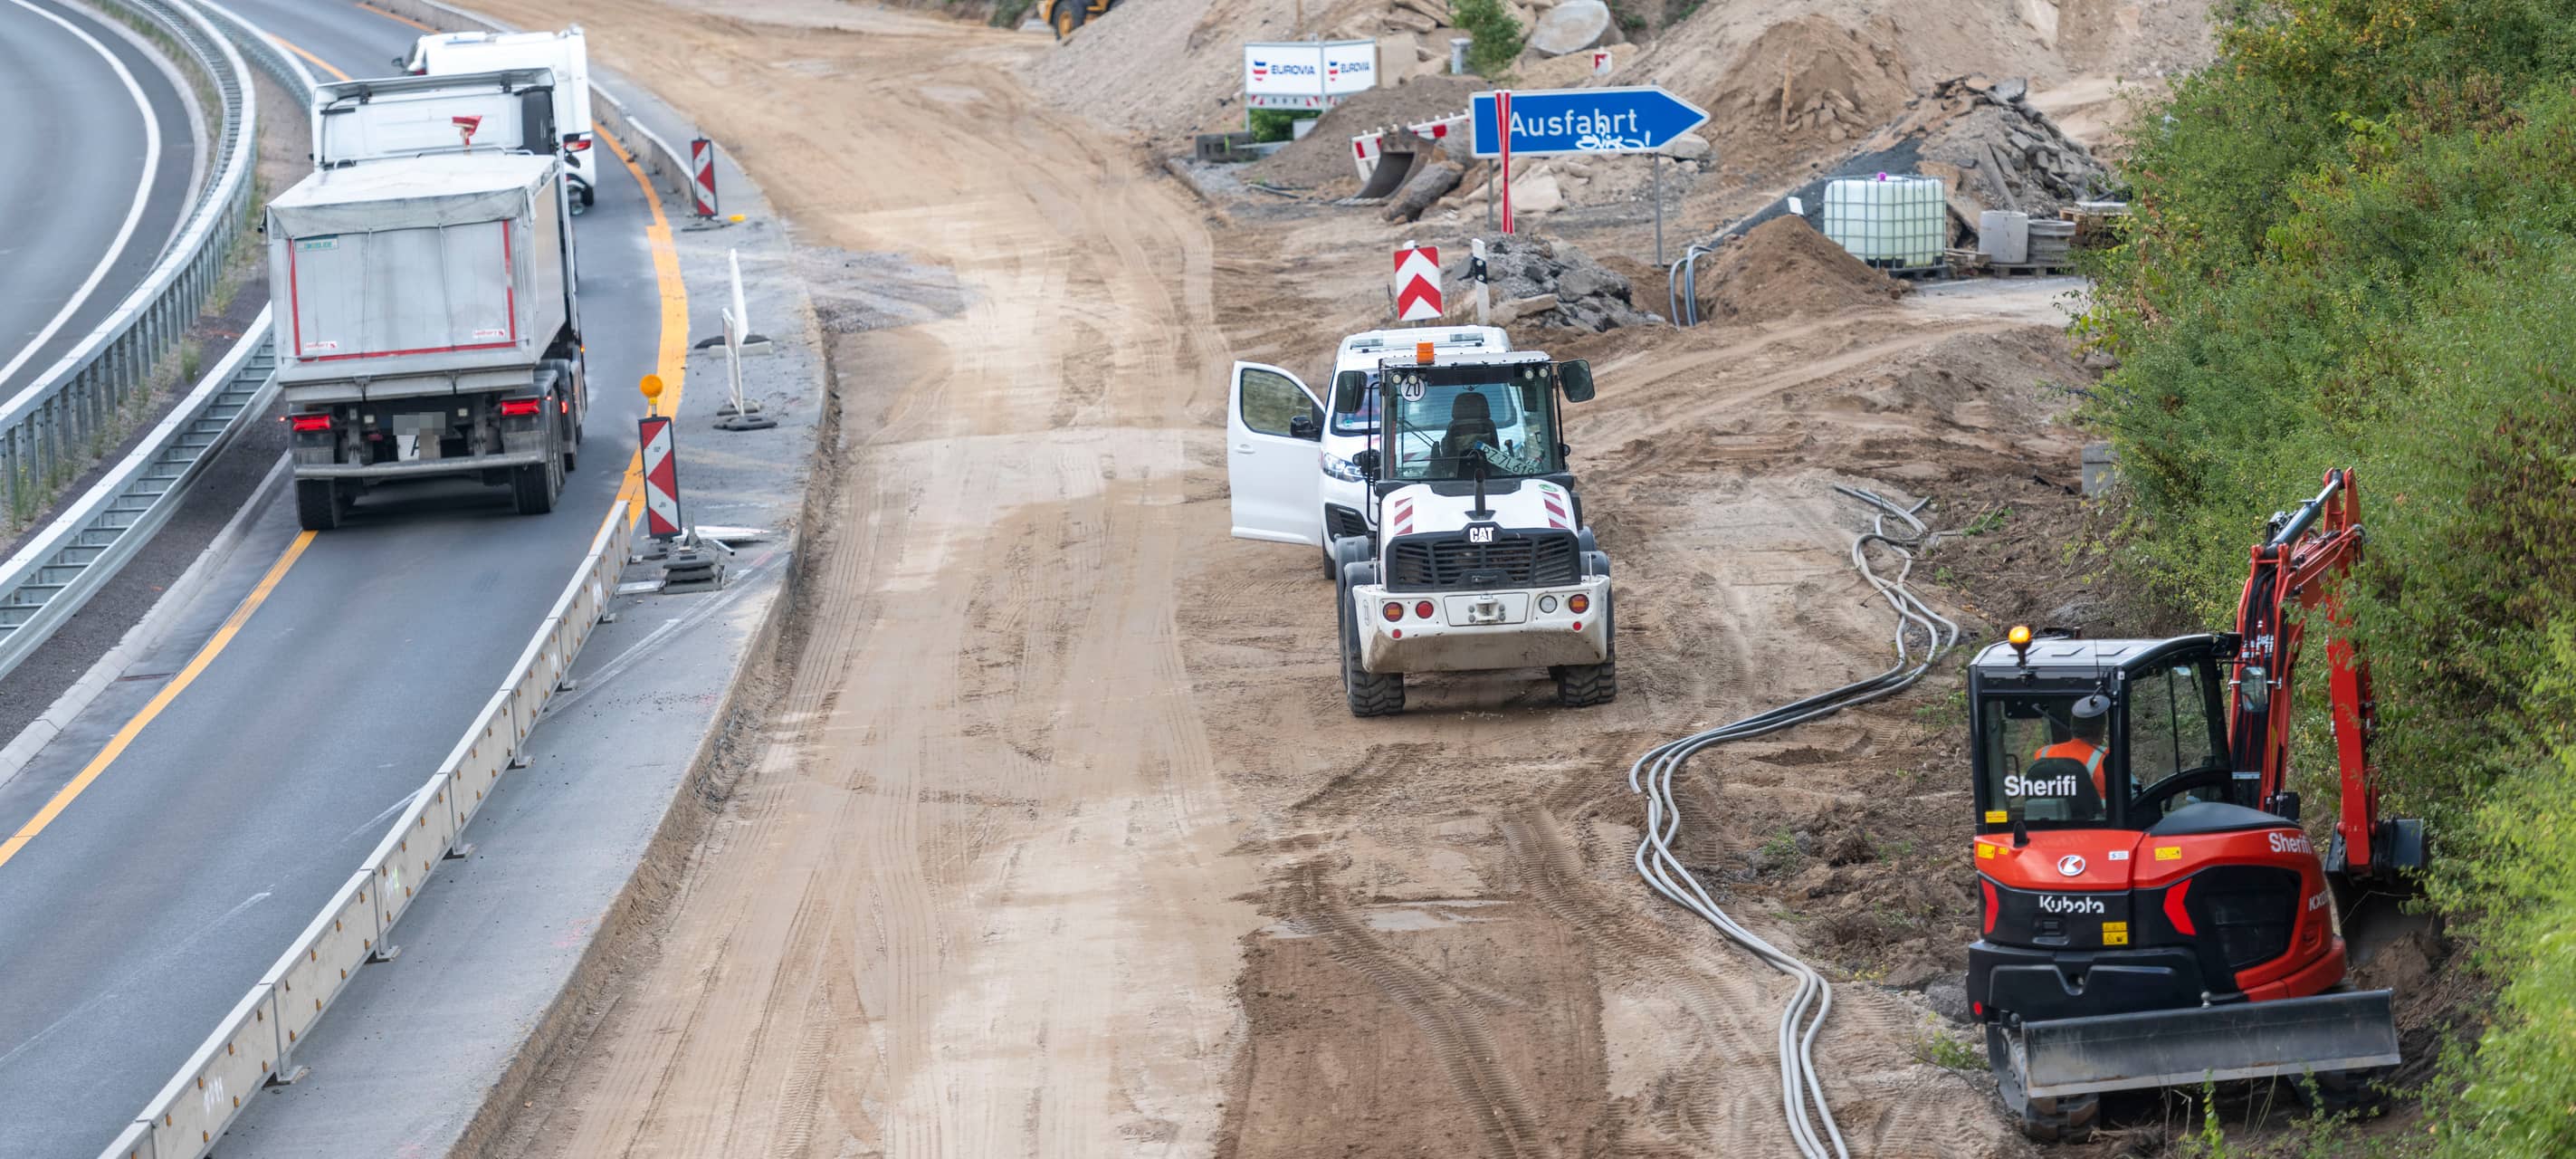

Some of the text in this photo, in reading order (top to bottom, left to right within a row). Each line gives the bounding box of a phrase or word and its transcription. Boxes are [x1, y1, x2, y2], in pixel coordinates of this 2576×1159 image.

[1271, 64, 1316, 74] EUROVIA
[1510, 108, 1638, 137] Ausfahrt
[1405, 378, 1421, 397] 20
[1469, 527, 1494, 543] CAT
[2004, 774, 2077, 797] Sherifi
[2039, 895, 2105, 914] Kubota
